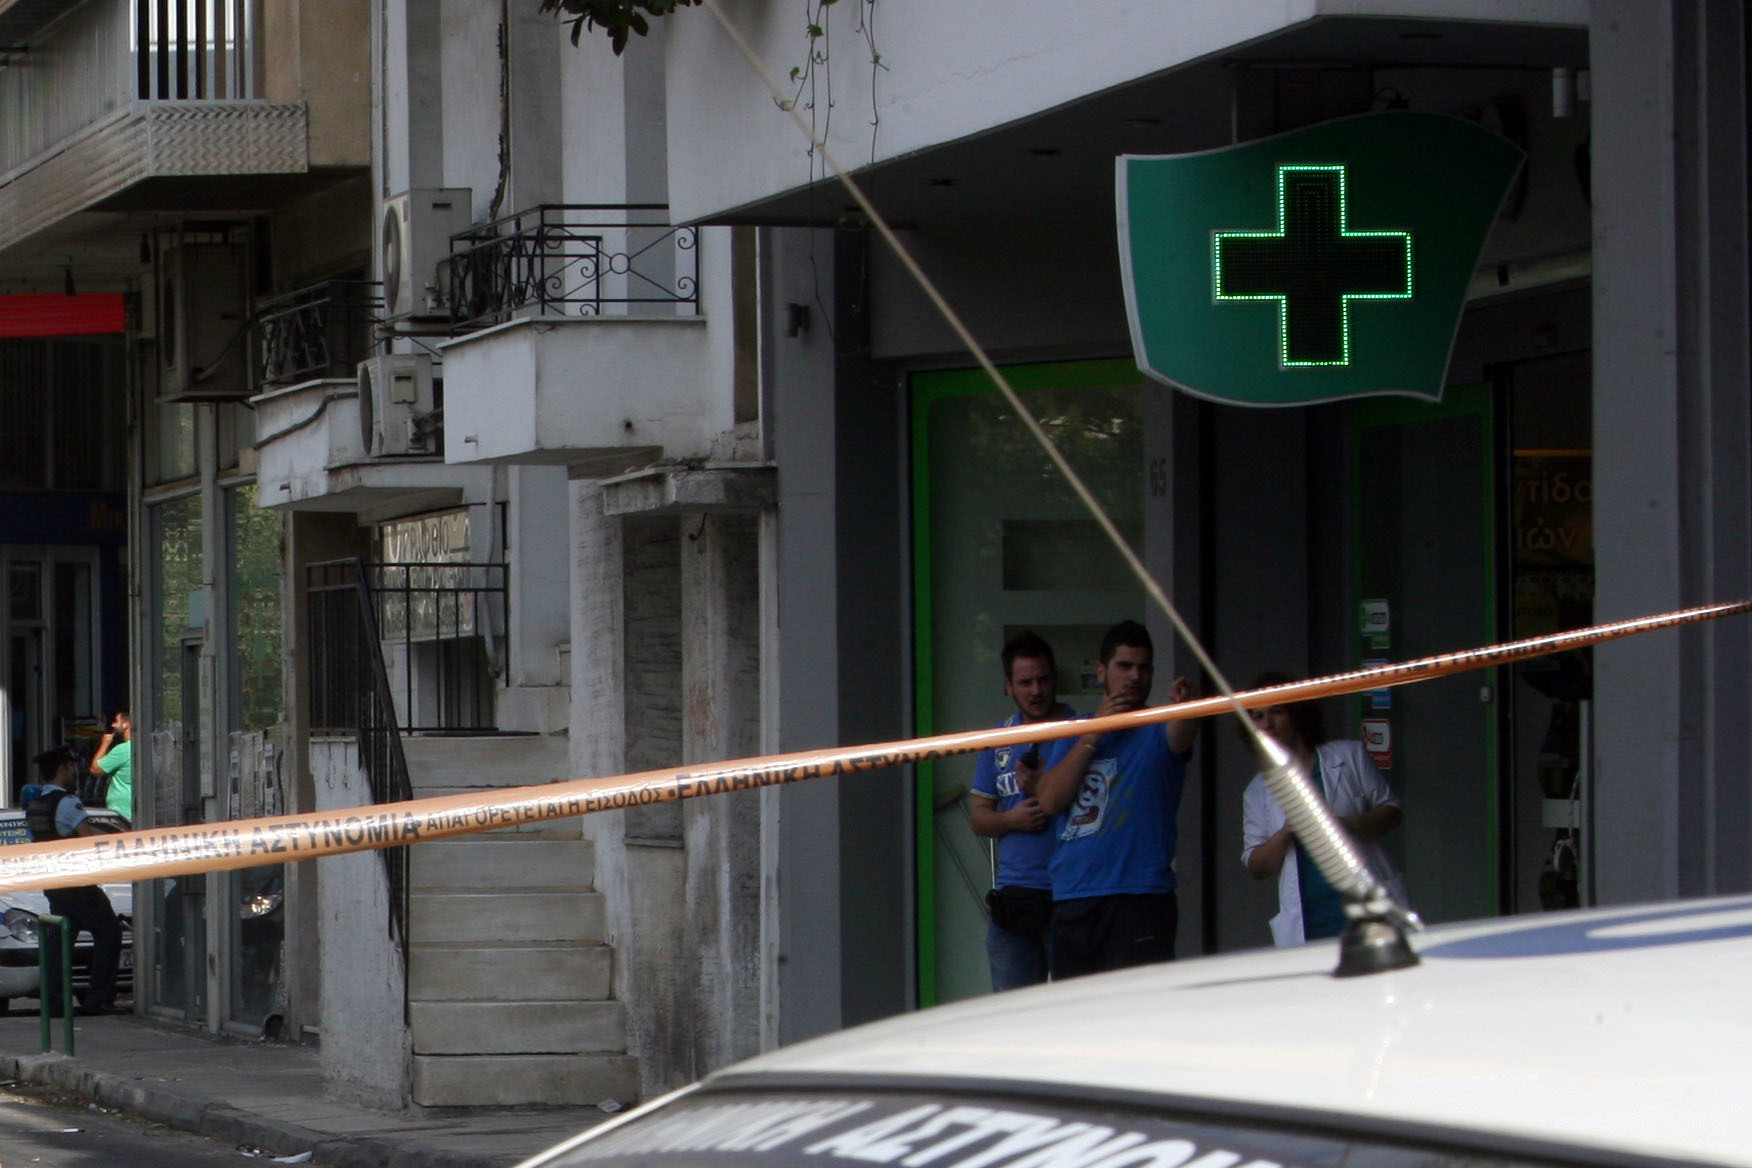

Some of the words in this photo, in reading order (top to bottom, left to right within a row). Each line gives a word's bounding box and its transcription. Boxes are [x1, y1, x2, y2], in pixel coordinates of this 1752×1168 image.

[1150, 455, 1167, 497] 65
[250, 811, 421, 856] ΑΣΤΥΝΟΜΙΑ
[426, 800, 565, 832] ΑΠΑΓΟΡΕΥΕΤΑΙ
[585, 787, 662, 812] ΕΙΣΟΔΟΣ
